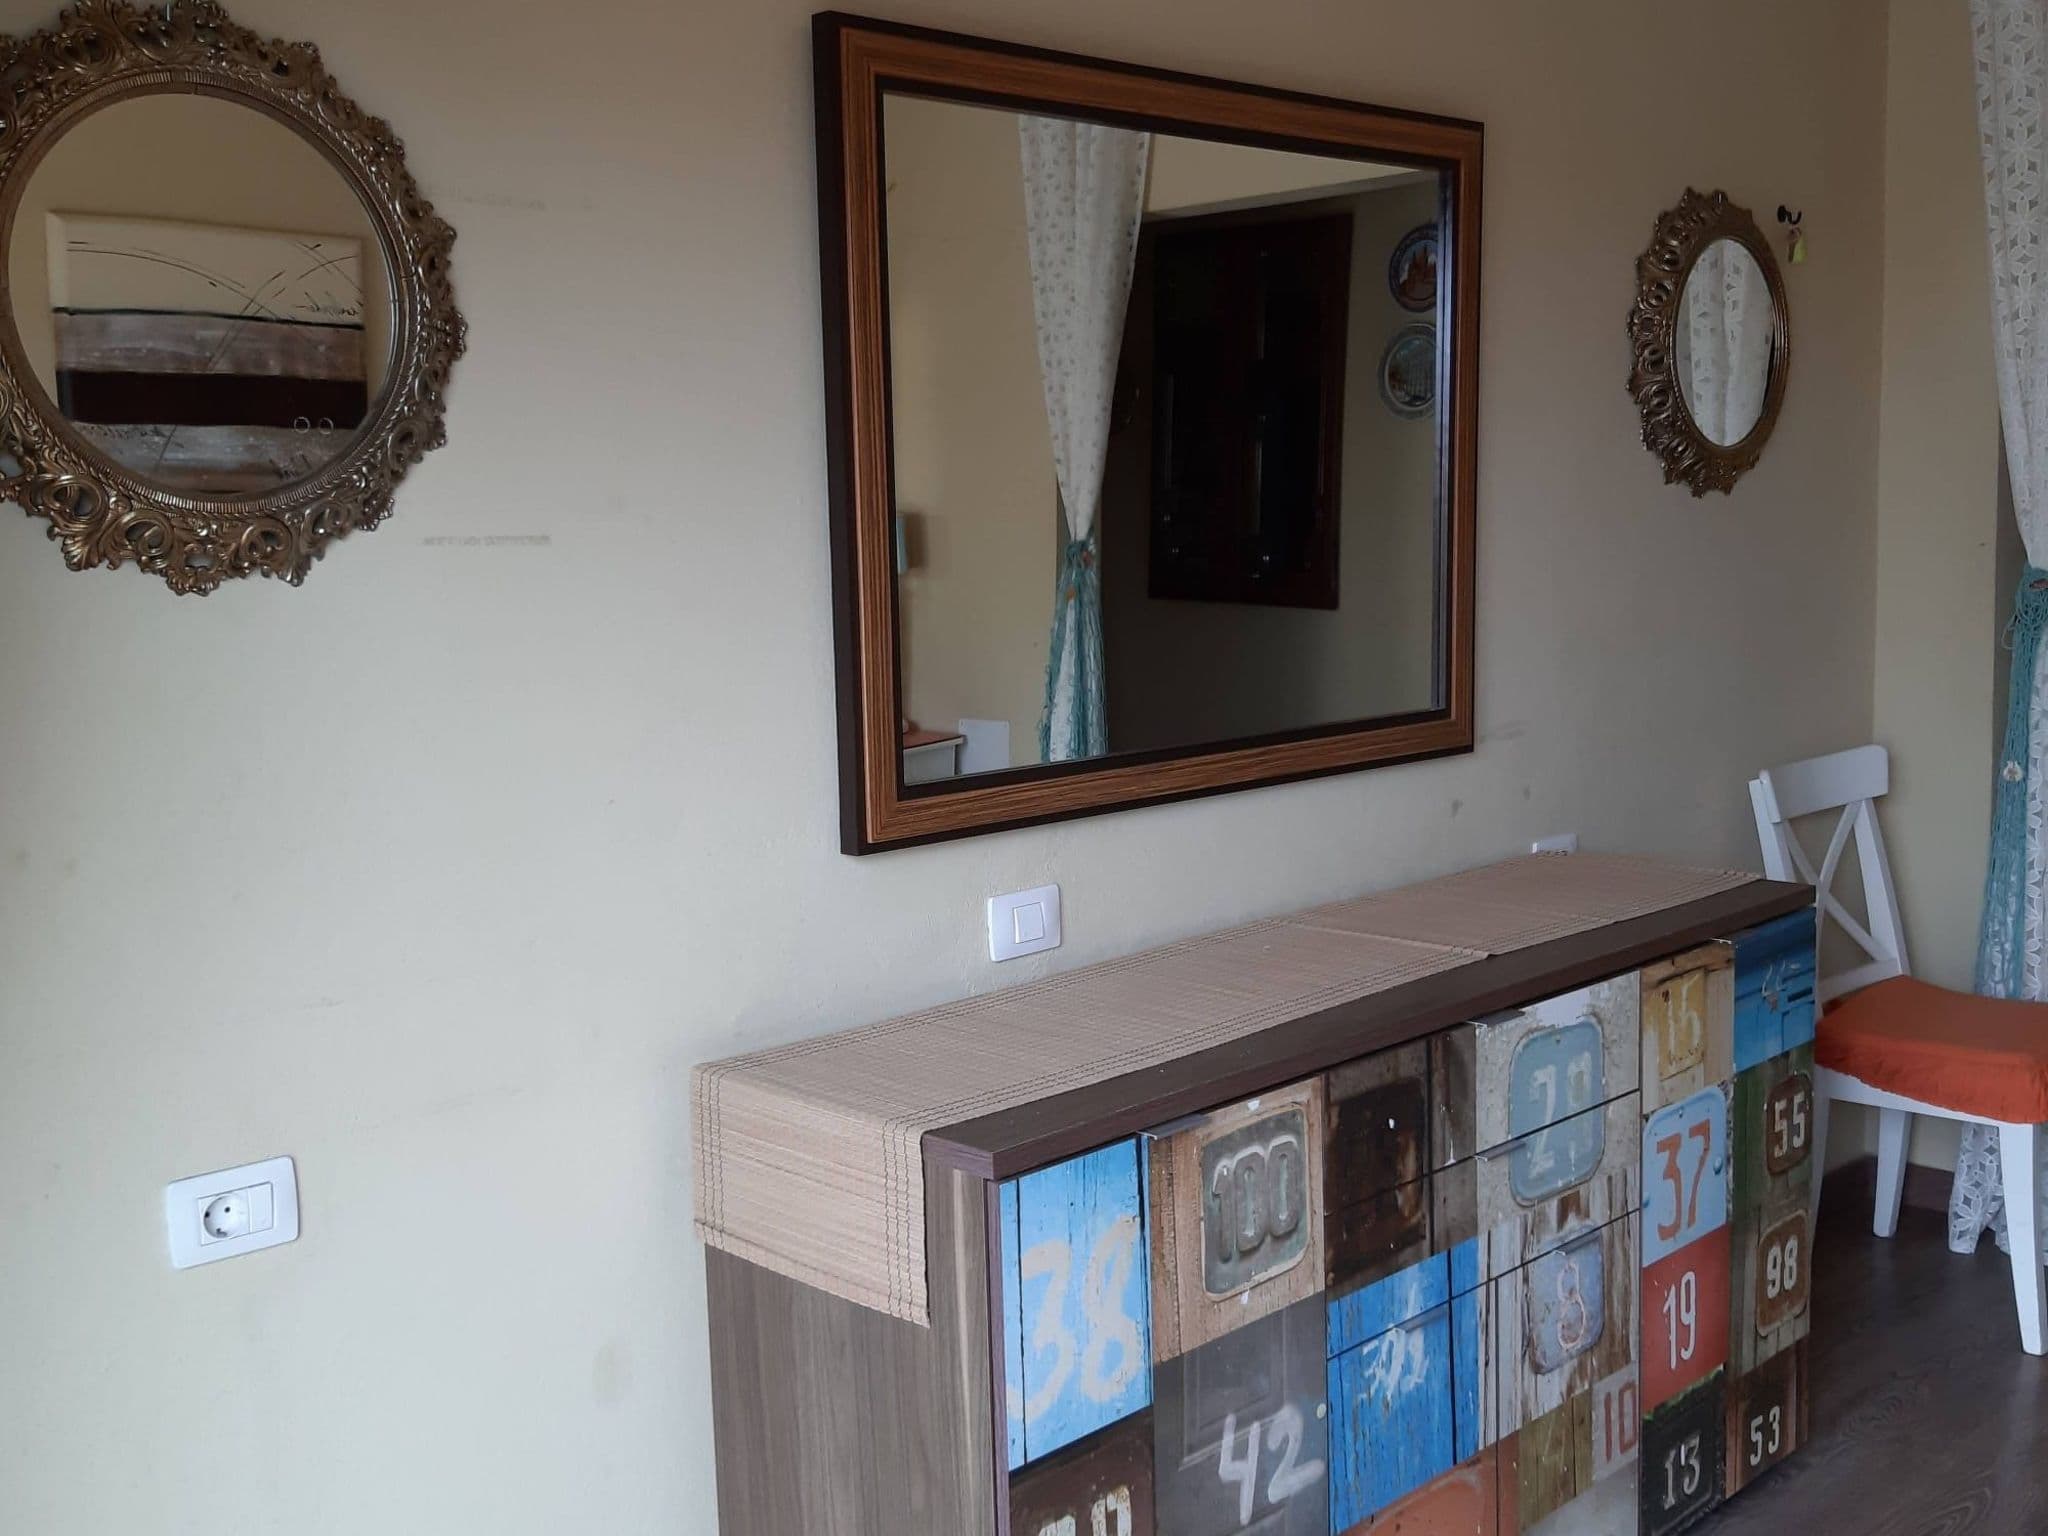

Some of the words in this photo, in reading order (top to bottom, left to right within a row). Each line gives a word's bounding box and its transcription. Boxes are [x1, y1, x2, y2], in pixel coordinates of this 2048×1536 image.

[1772, 1094, 1806, 1159] 55
[1212, 1134, 1300, 1264] 100
[1656, 1119, 1711, 1241] 37
[1766, 1235, 1798, 1299] 98
[1008, 1214, 1142, 1424] 38
[1662, 1271, 1697, 1370] 19
[1218, 1404, 1327, 1526] 42
[1604, 1381, 1637, 1463] 10
[1750, 1406, 1780, 1467] 53
[1663, 1434, 1700, 1511] 13
